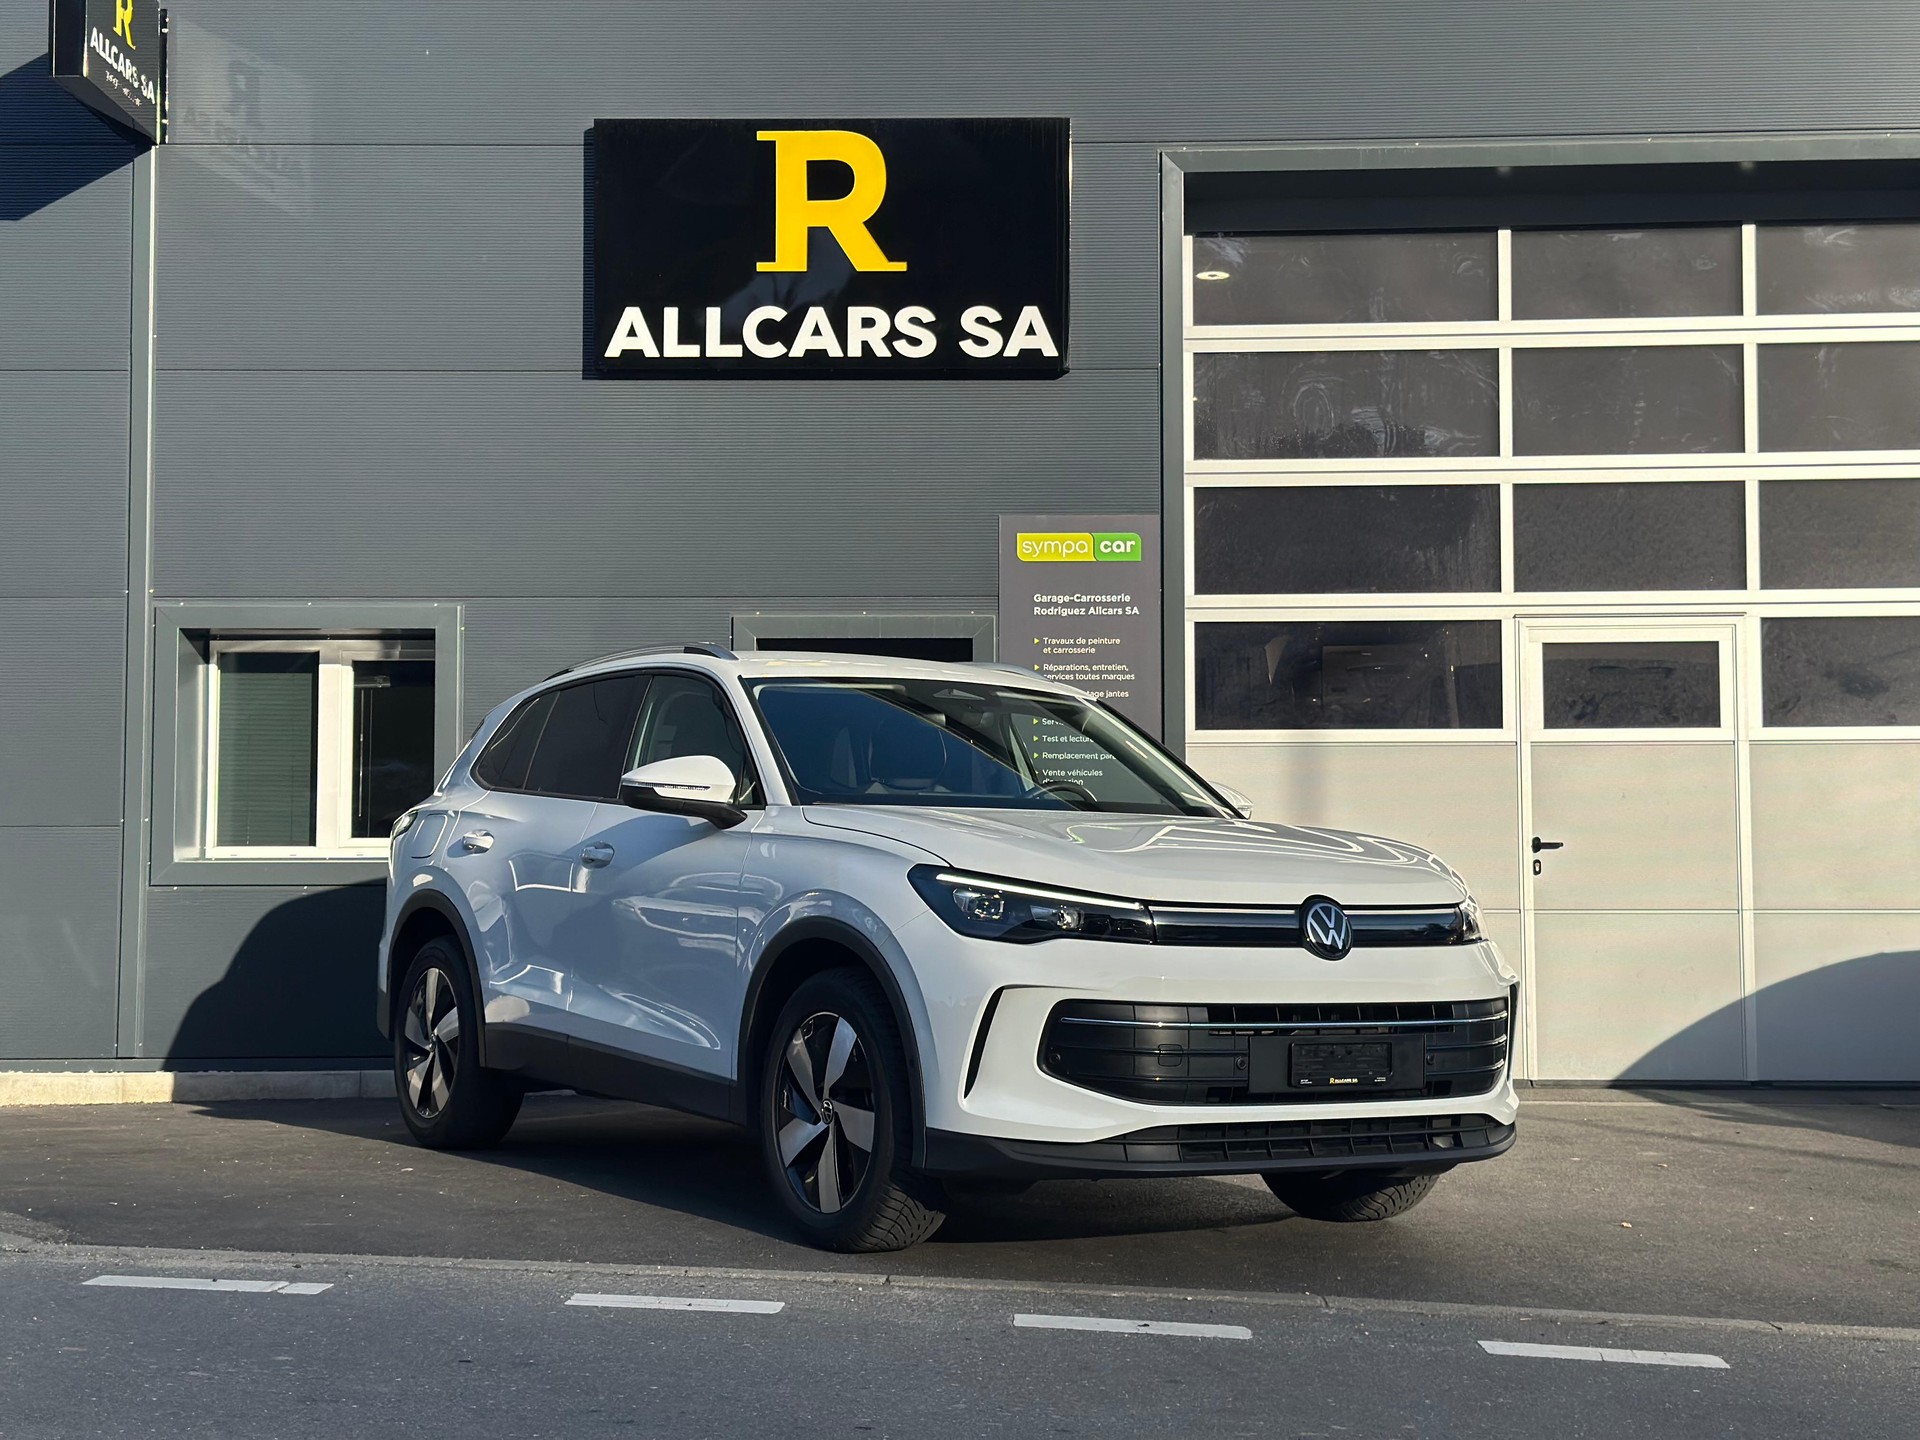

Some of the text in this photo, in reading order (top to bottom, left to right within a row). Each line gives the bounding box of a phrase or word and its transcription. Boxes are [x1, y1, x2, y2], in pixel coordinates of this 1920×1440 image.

[90, 27, 139, 89] ALLCARS
[141, 74, 155, 105] SA
[757, 130, 907, 272] R
[604, 305, 1059, 358] ALLCARS SA
[1022, 540, 1136, 558] sympa car
[1033, 593, 1131, 604] Garage-Carrosserie
[1033, 606, 1140, 617] Rodriguez Allcars SA
[1043, 637, 1121, 646] Travaux de peinture
[1053, 646, 1096, 654] carrosserie
[1043, 663, 1129, 672] Réparations, entretien,
[1105, 690, 1129, 698] jantes
[1042, 735, 1058, 743] Test
[1060, 735, 1068, 743] et
[1042, 751, 1098, 760] Remplacement
[1042, 768, 1104, 777] Vente véhicules
